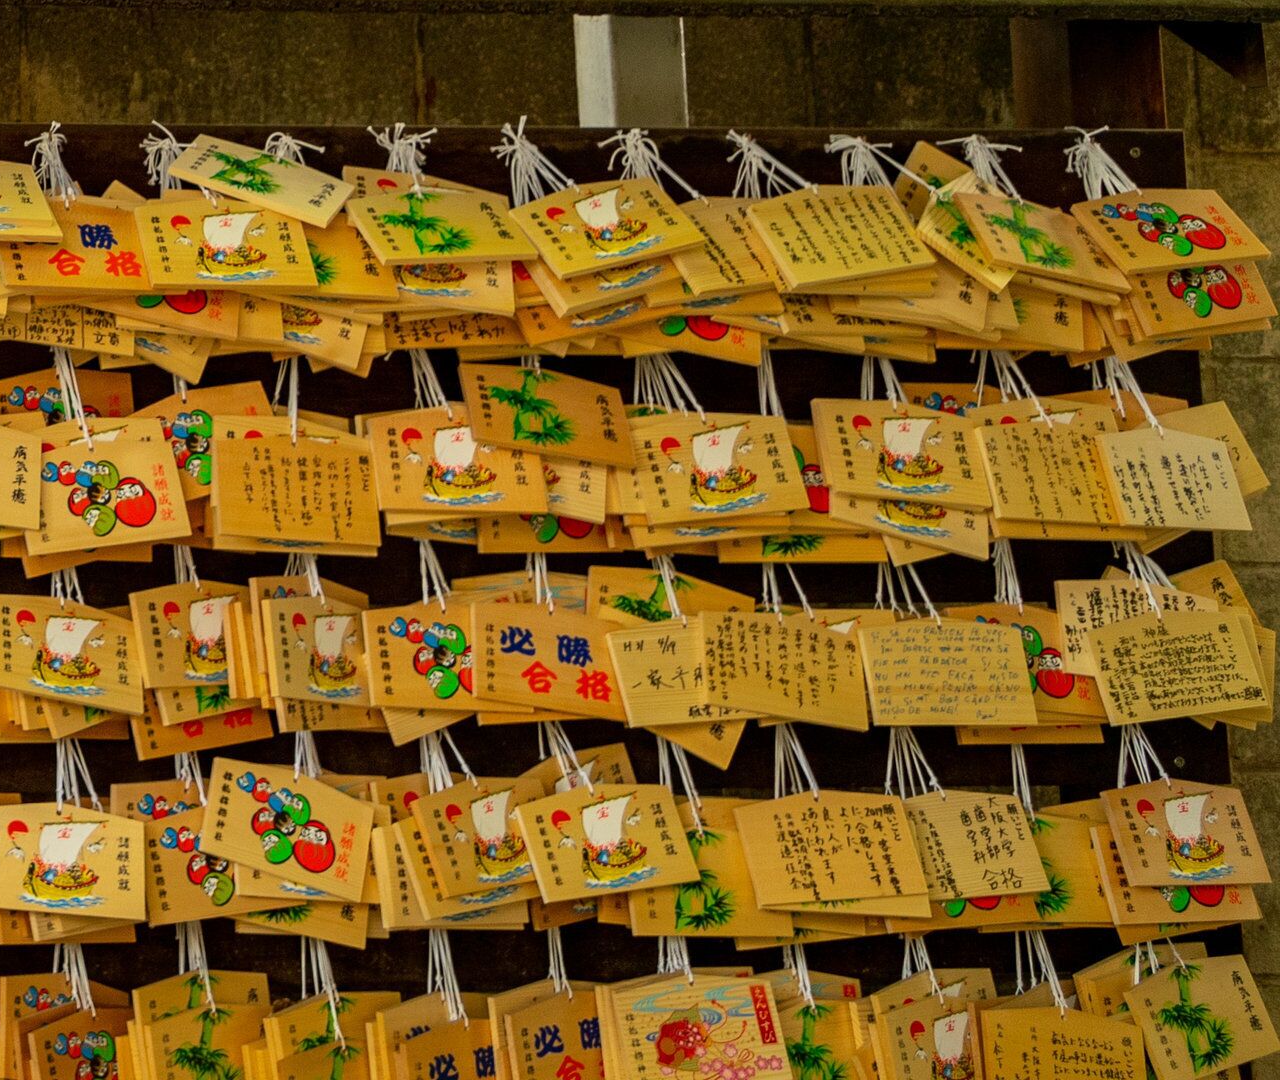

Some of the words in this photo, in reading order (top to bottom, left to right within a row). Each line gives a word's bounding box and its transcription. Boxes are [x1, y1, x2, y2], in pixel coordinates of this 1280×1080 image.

[48, 249, 142, 278] 合格
[12, 445, 28, 505] 病気平癒
[152, 463, 175, 521] 諸願成就
[500, 627, 593, 668] 必勝
[521, 661, 612, 702] 合格
[883, 803, 901, 841] 願いごと
[988, 796, 1016, 858] 大阪大学
[1007, 804, 1025, 840] 願いごと
[116, 836, 131, 892] 諸願成就
[982, 867, 1023, 890] 合格
[752, 985, 776, 1043] えんむすび
[1231, 970, 1263, 1032] 病気平癒
